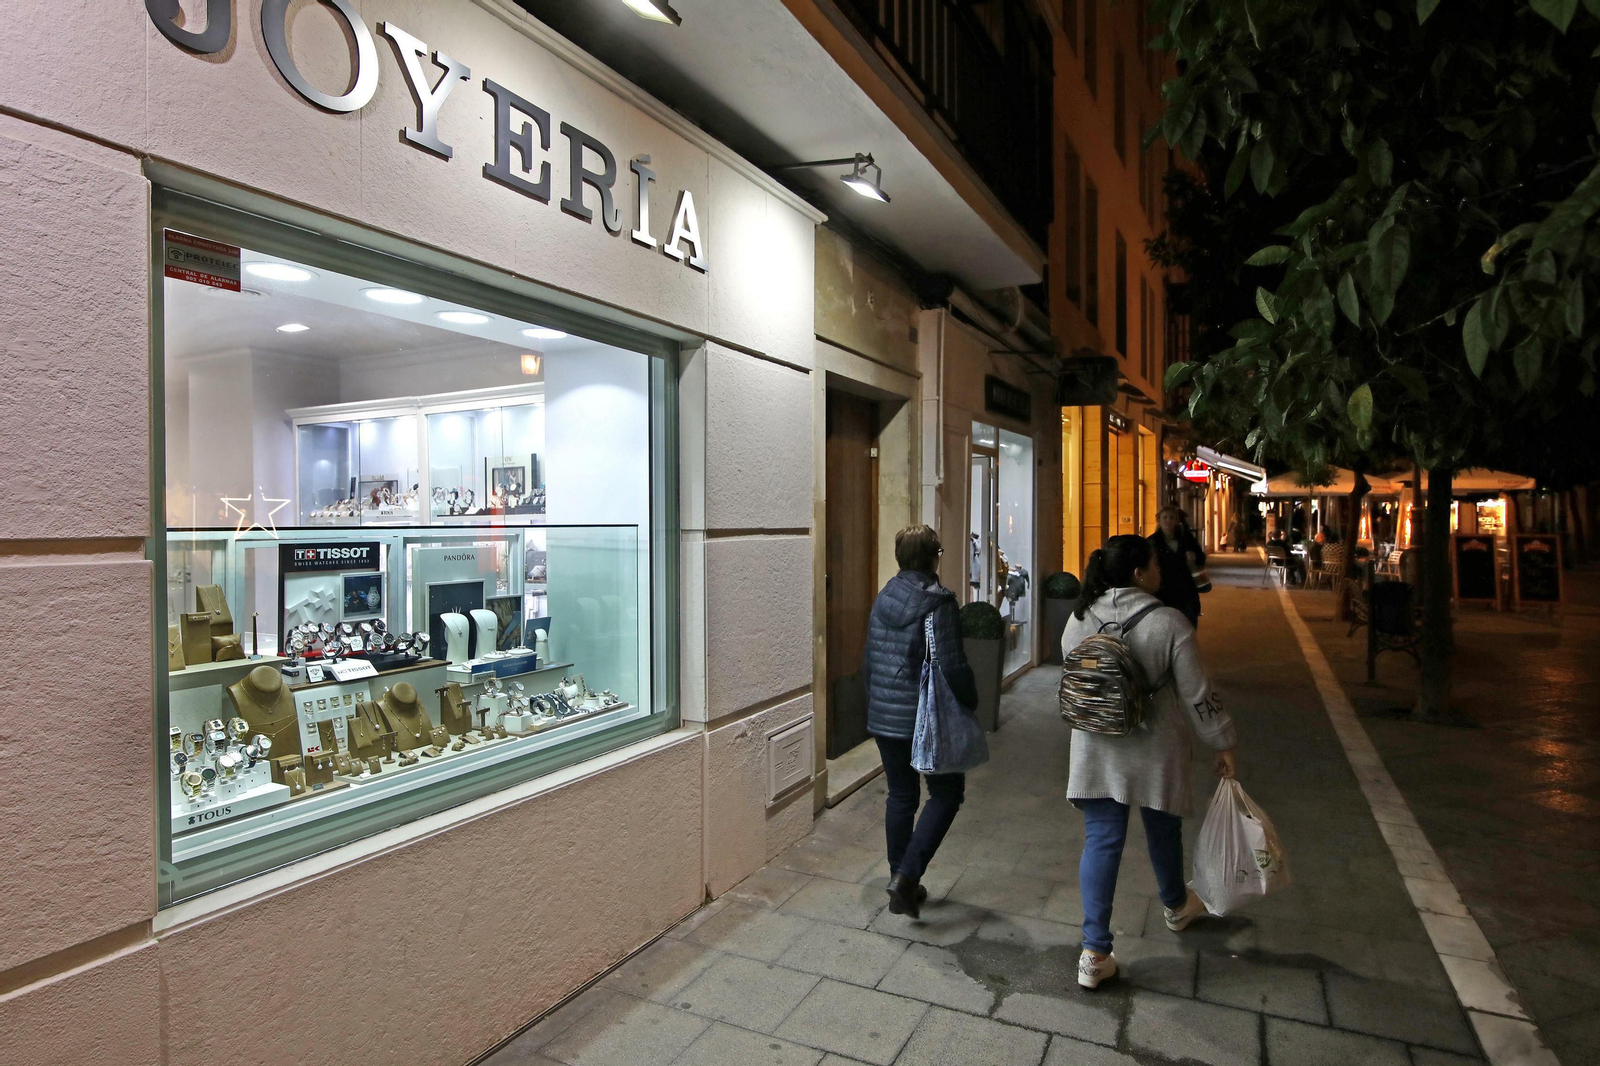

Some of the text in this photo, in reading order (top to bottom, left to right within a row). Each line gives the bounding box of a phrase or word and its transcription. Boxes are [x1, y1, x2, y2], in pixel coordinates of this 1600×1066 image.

[168, 233, 192, 243] ALARMA
[193, 240, 227, 252] CONECTADA
[169, 267, 198, 277] CENTRAL
[210, 276, 238, 286] ALARMAS
[317, 547, 370, 559] TISSOT
[348, 664, 373, 675] TISSOT
[1193, 692, 1223, 722] FAS
[196, 806, 232, 822] TOUS
